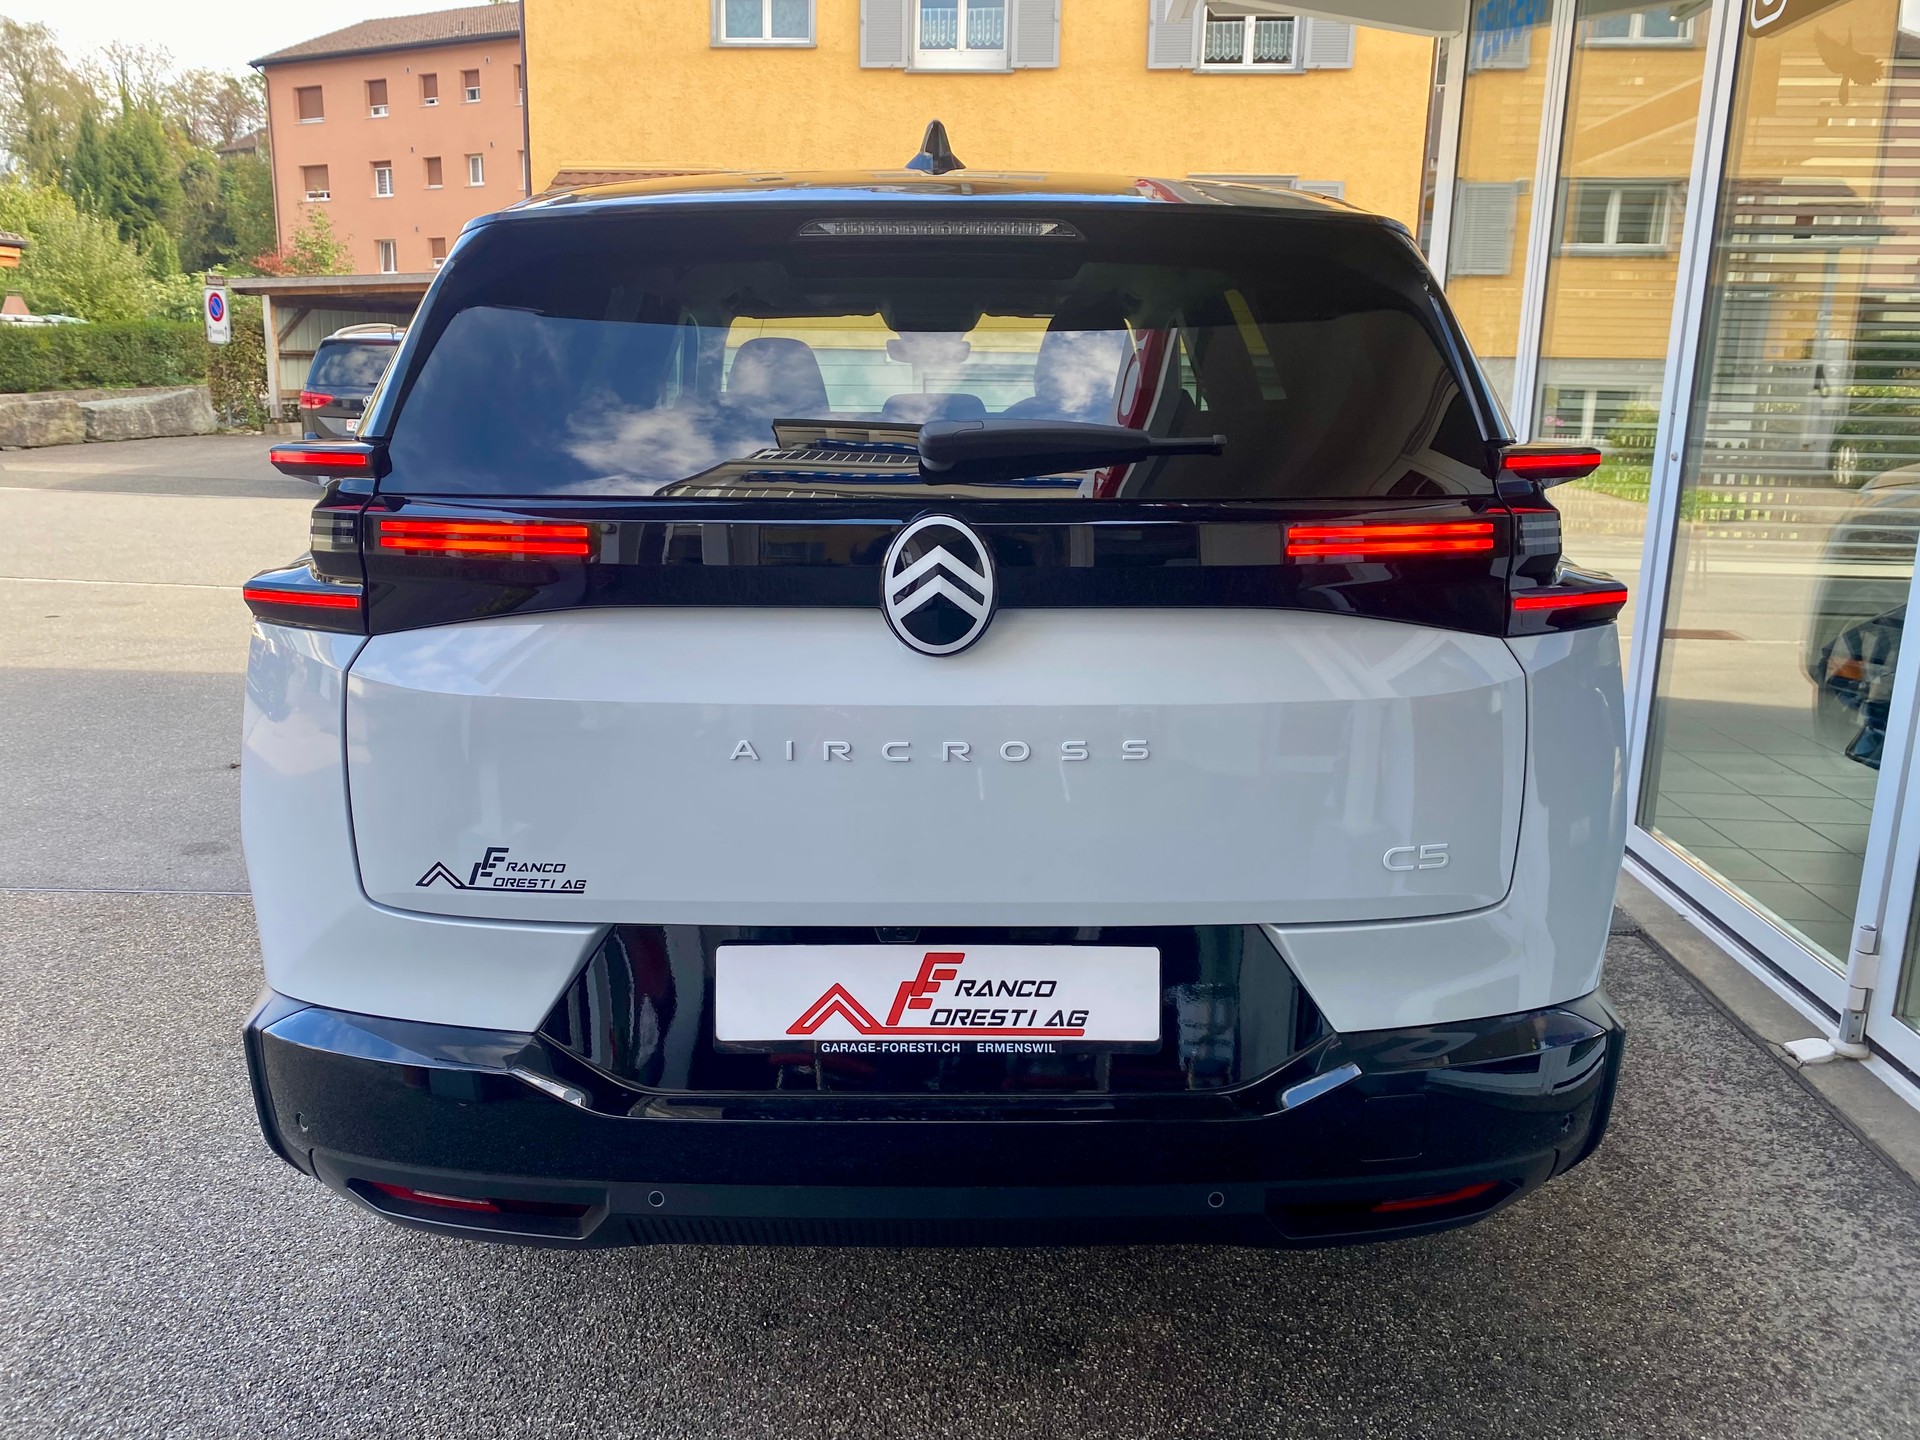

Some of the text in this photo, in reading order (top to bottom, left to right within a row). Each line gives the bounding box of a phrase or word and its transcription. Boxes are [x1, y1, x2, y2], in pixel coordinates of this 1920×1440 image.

[729, 740, 1151, 762] AIRCROSS
[481, 847, 567, 873] FRANCO
[1382, 843, 1450, 872] C5
[468, 862, 588, 890] FORESTI AG
[911, 952, 1058, 998] FRANCO
[886, 981, 1090, 1027] FORESTI AG
[820, 1042, 1057, 1054] GARAGE-FORESTI.CH ERMENSWIL
